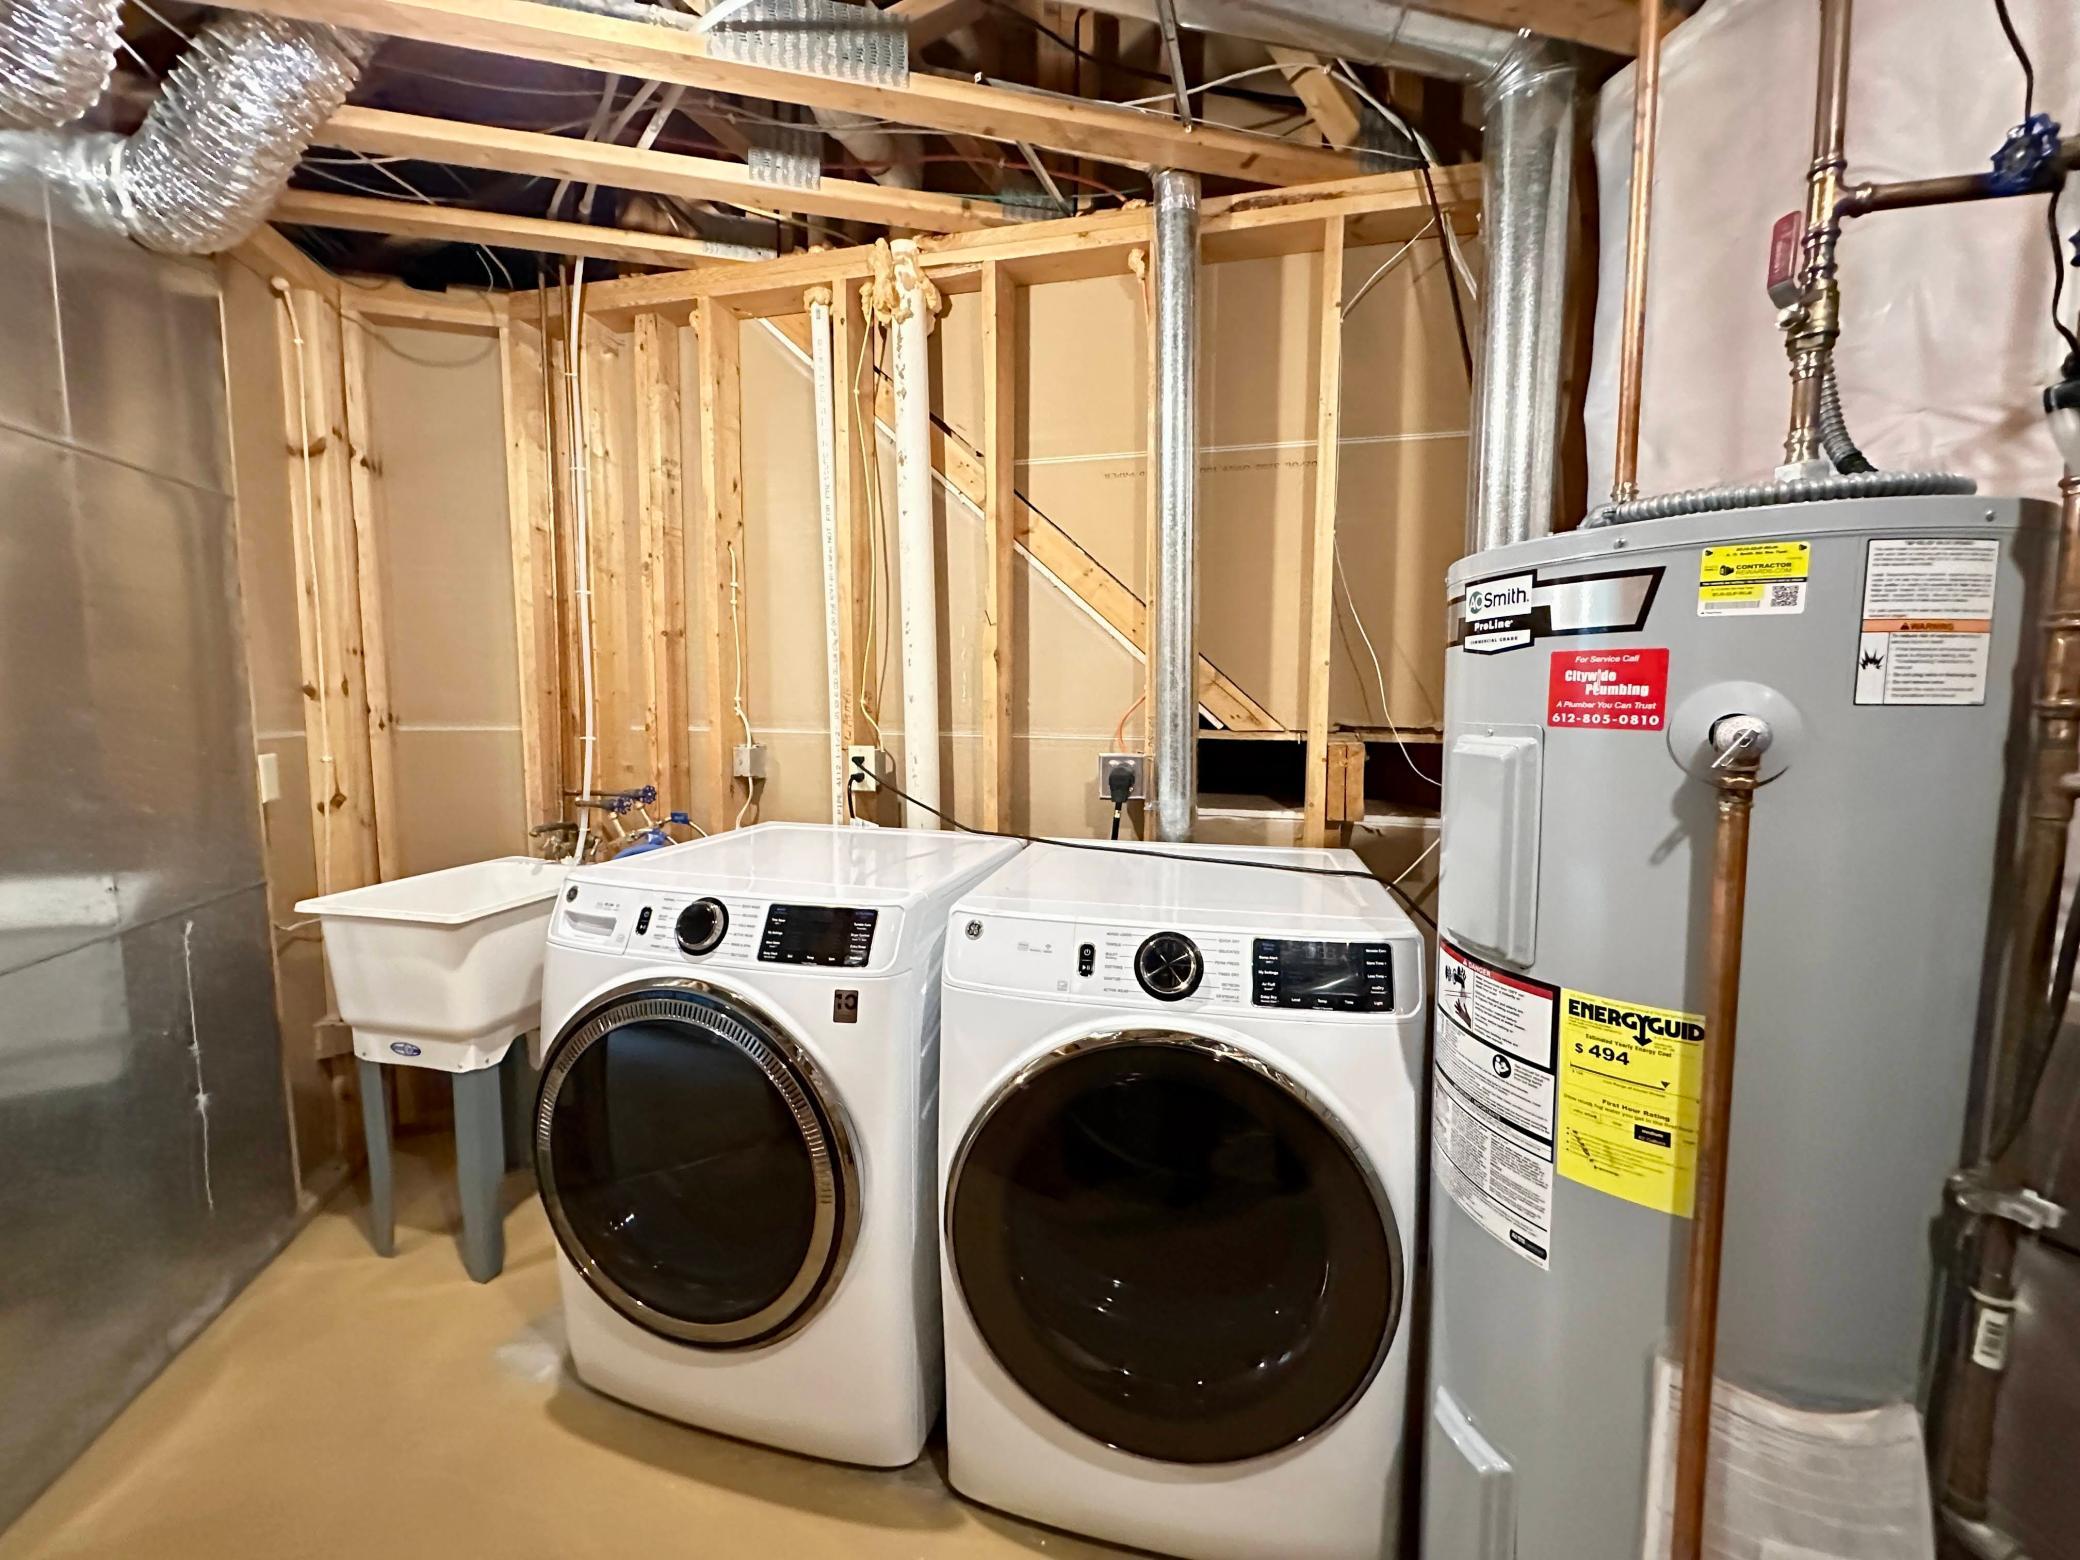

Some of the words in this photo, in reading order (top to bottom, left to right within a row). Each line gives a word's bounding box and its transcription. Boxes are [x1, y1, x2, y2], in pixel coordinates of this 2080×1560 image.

[1484, 587, 1527, 609] Smith
[1474, 619, 1513, 632] ProLine
[1575, 655, 1589, 663] For
[1589, 655, 1621, 663] Service
[1622, 654, 1640, 662] Call
[1565, 668, 1617, 682] Citywide
[1585, 681, 1650, 697] Plumbing
[1556, 700, 1562, 708] A
[1597, 701, 1613, 709] You
[1552, 712, 1660, 725] 612-805-0810
[1468, 961, 1491, 977] DANGER
[1569, 998, 1705, 1042] ENERGYGUID
[1585, 1033, 1613, 1045] Estimated
[1614, 1041, 1633, 1051] Yearly
[1634, 1045, 1656, 1056] Energy
[1657, 1050, 1672, 1058] Cost
[1574, 1043, 1584, 1054] $
[1588, 1044, 1630, 1066] 494
[1602, 1099, 1619, 1109] First
[1621, 1104, 1641, 1114] Hour
[1643, 1110, 1670, 1122] Rating
